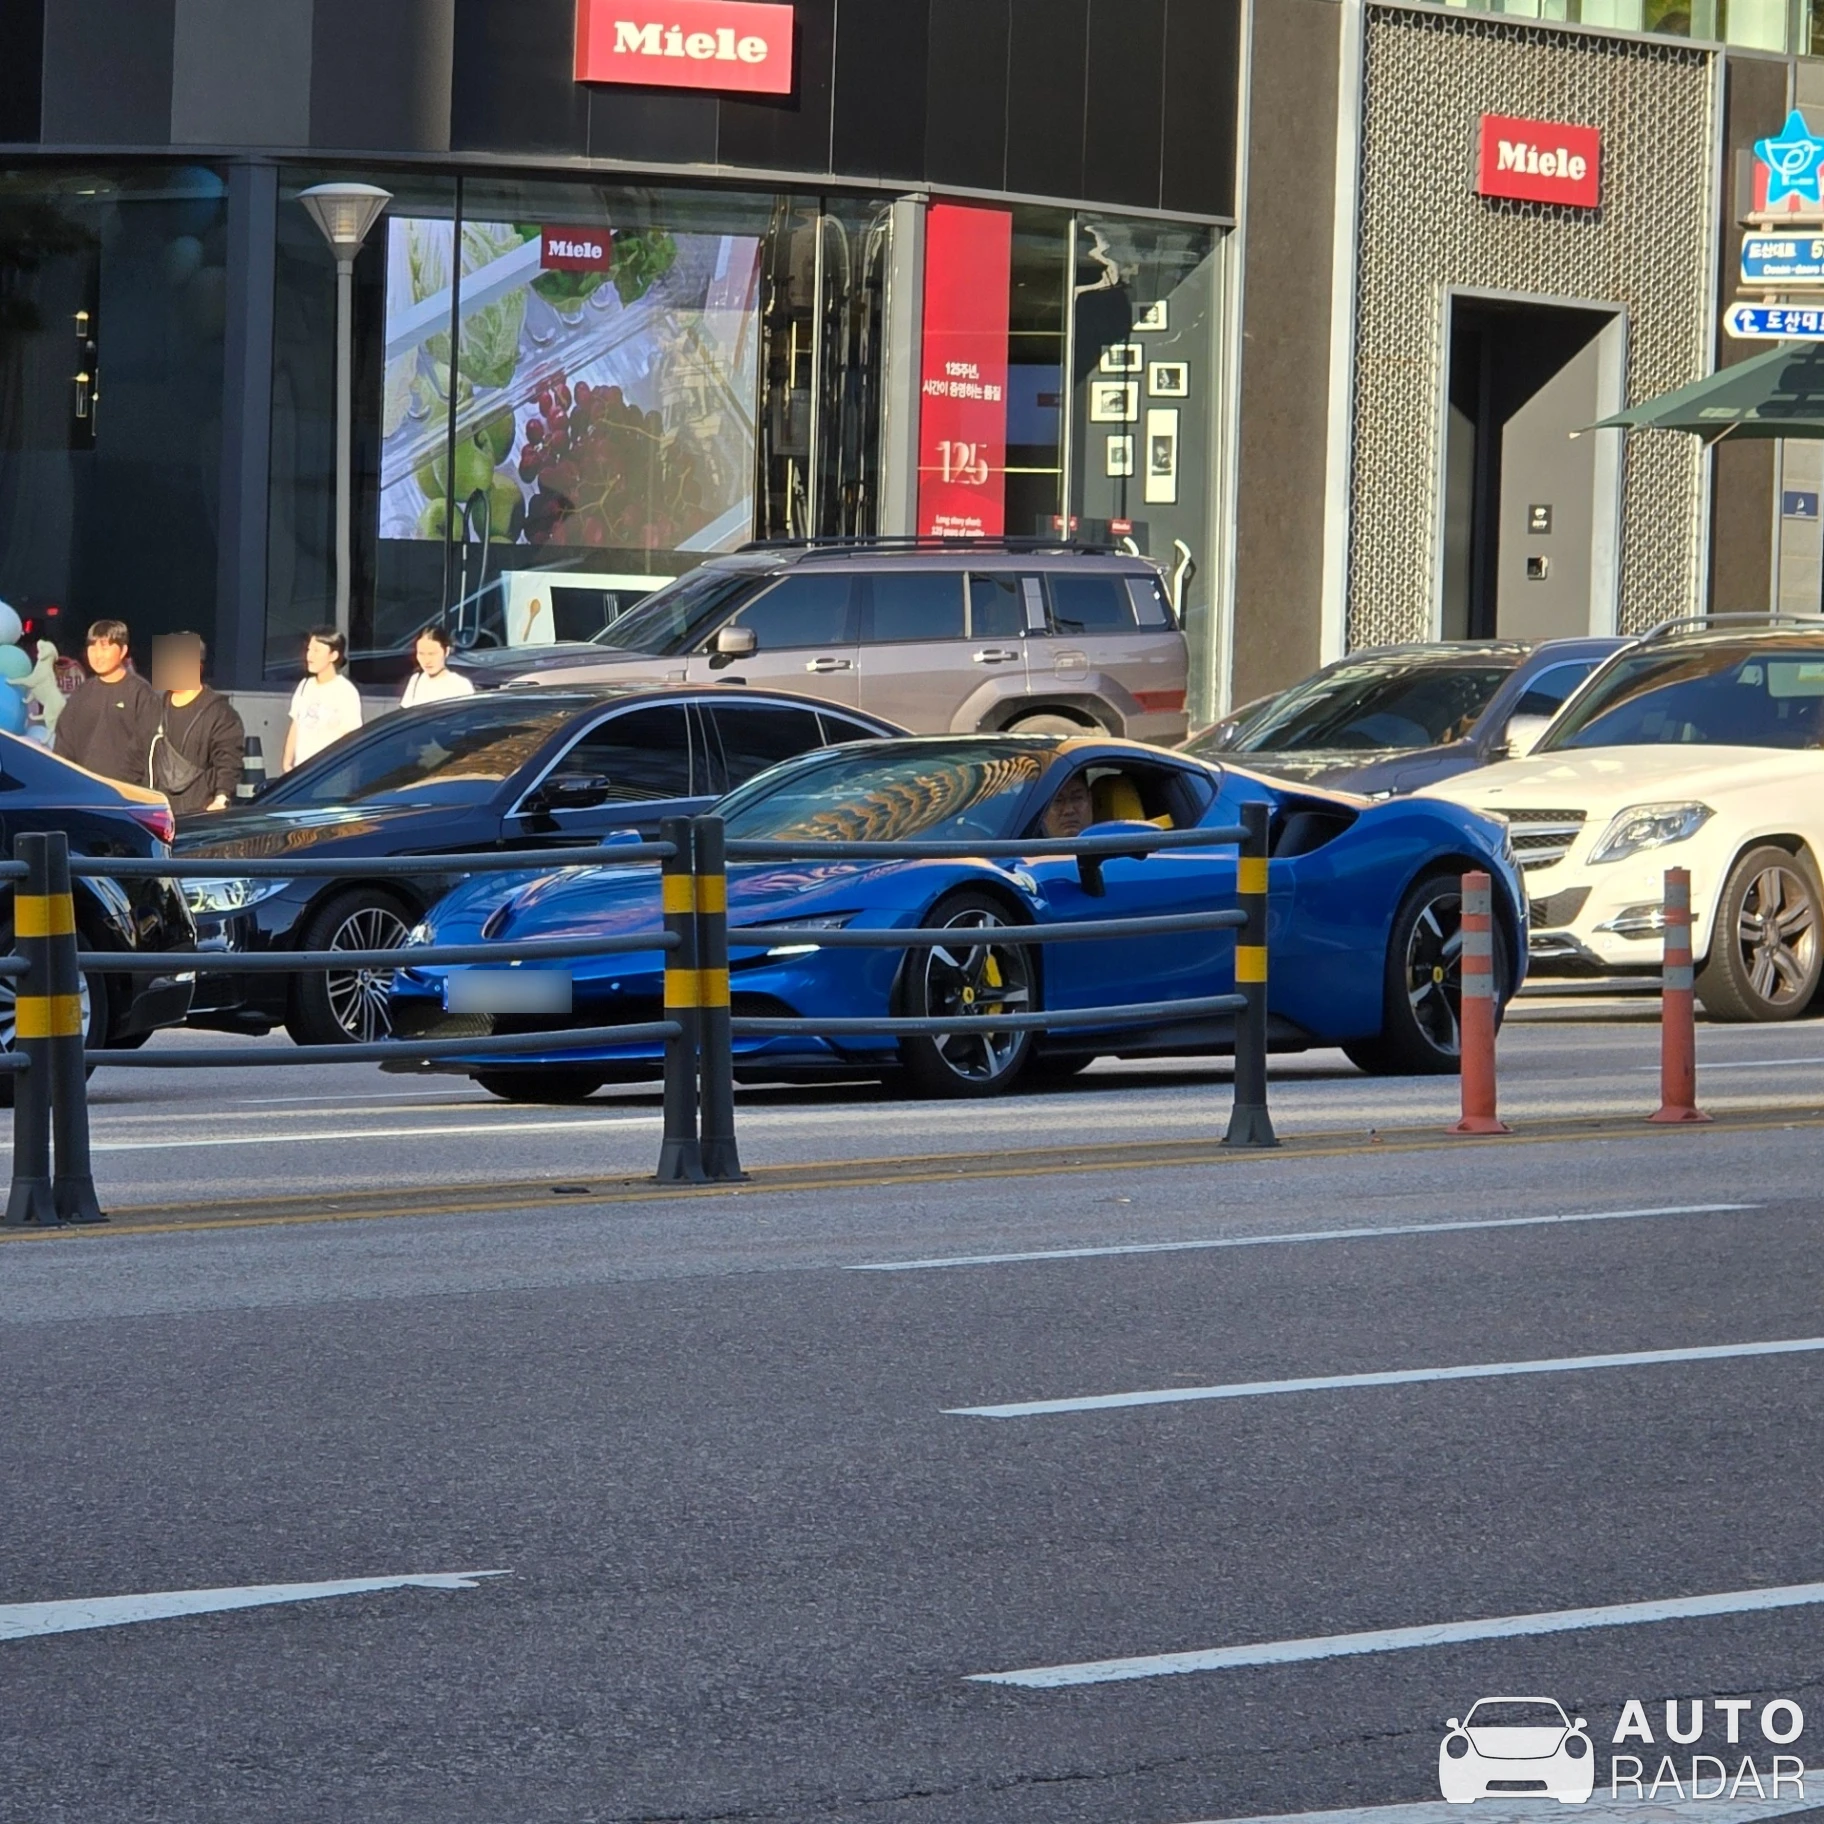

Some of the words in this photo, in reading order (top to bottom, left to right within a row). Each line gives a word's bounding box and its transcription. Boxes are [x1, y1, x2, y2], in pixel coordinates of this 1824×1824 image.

[613, 21, 768, 63] Miele
[1497, 140, 1587, 181] Miele
[548, 240, 603, 259] Miele
[922, 379, 949, 397] 시간이
[935, 440, 989, 486] 125
